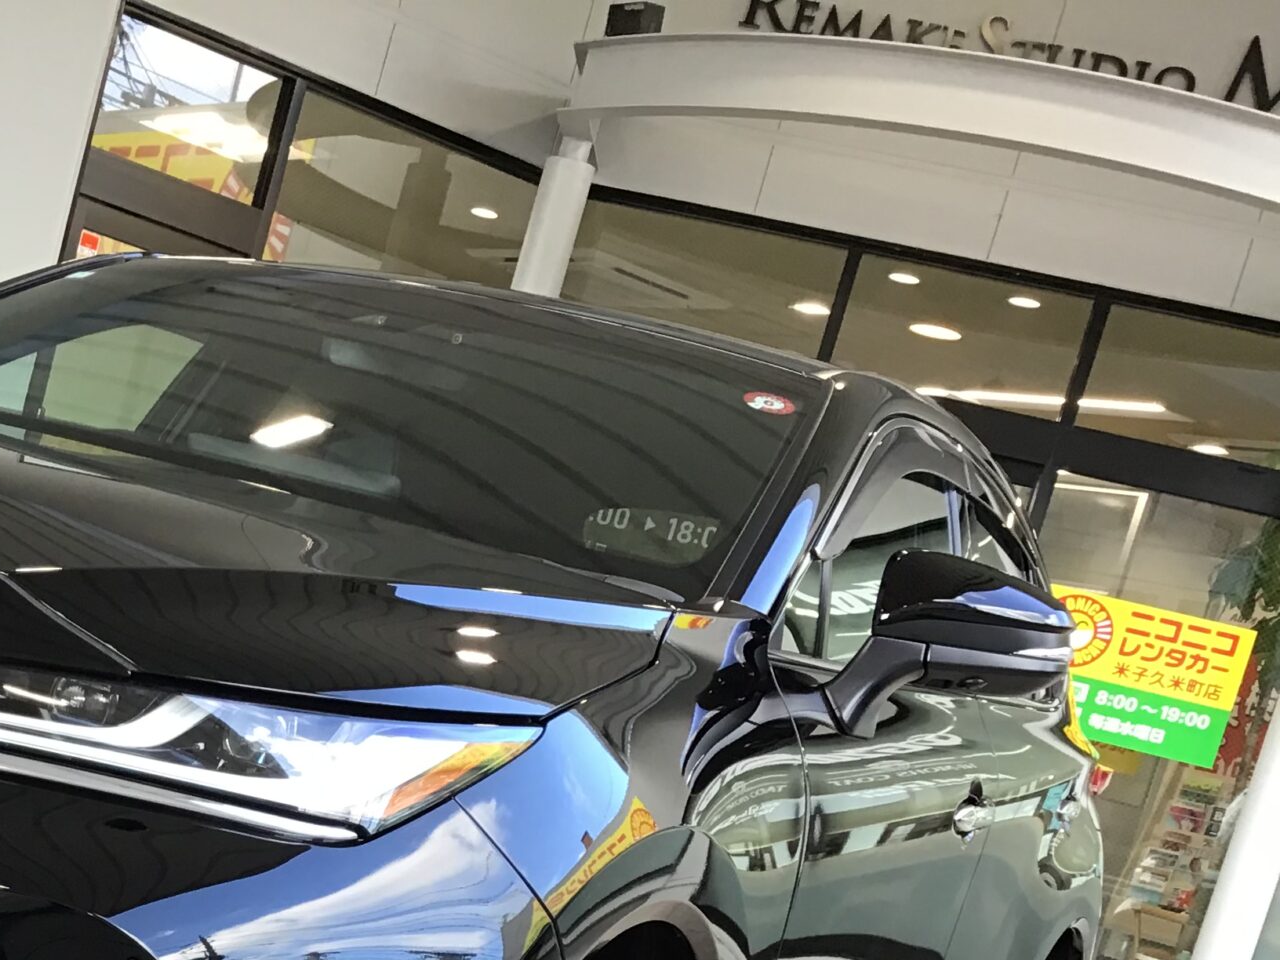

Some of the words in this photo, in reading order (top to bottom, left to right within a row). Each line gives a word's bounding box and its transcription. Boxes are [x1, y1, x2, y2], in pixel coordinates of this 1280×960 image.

[1125, 611, 1240, 657] ニコニコ
[1119, 637, 1229, 674] レンタカー
[1112, 662, 1224, 701] 米子久米町店
